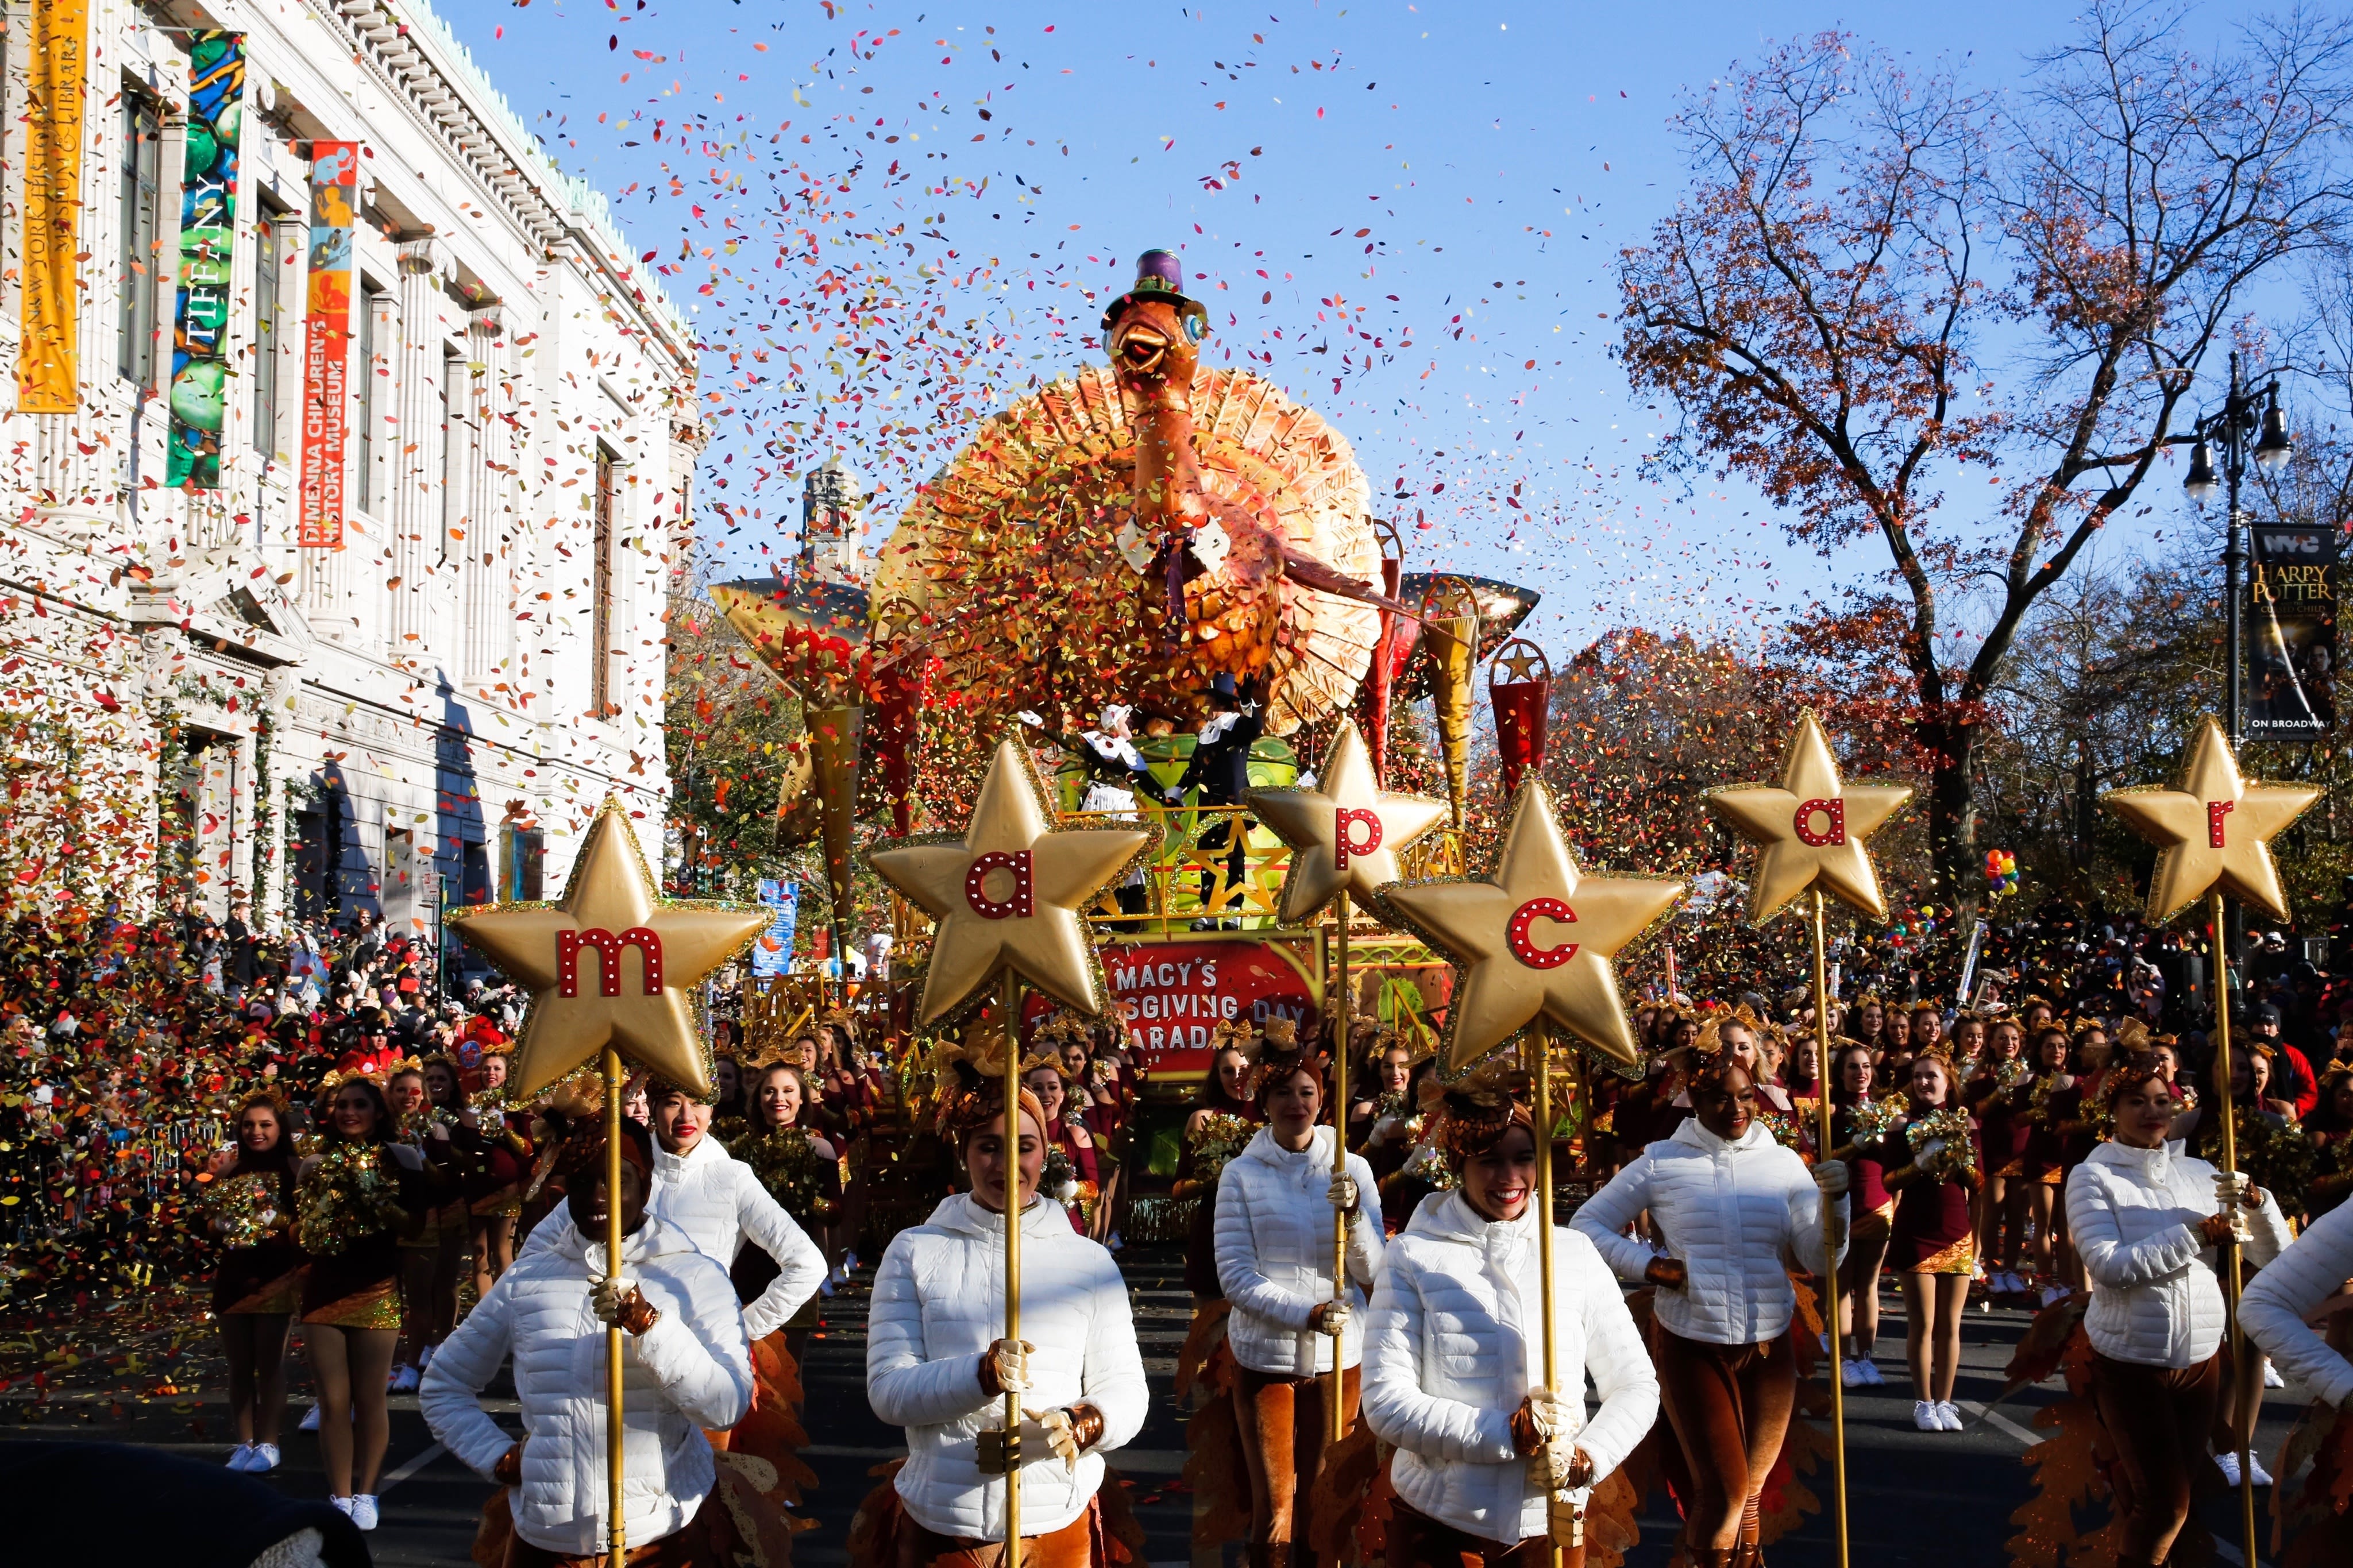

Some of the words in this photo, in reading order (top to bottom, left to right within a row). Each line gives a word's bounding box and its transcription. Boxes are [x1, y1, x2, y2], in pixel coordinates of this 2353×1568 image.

[58, 34, 78, 125] LIBRARY
[186, 173, 225, 346] TIFFANY
[307, 320, 326, 438] CHILDREN'S
[325, 361, 344, 452] MUSEUM
[323, 458, 340, 543] HISTORY
[2264, 535, 2319, 553] NYC
[2252, 582, 2335, 603] POTTER
[2297, 605, 2326, 613] CHILD
[2252, 720, 2269, 728] ON
[2272, 720, 2331, 728] BROADWAY
[1336, 808, 1383, 871] p
[1795, 797, 1846, 849] a
[2207, 800, 2234, 848] r
[965, 849, 1034, 920] a
[559, 927, 663, 998] m
[1254, 999, 1305, 1030] DAY
